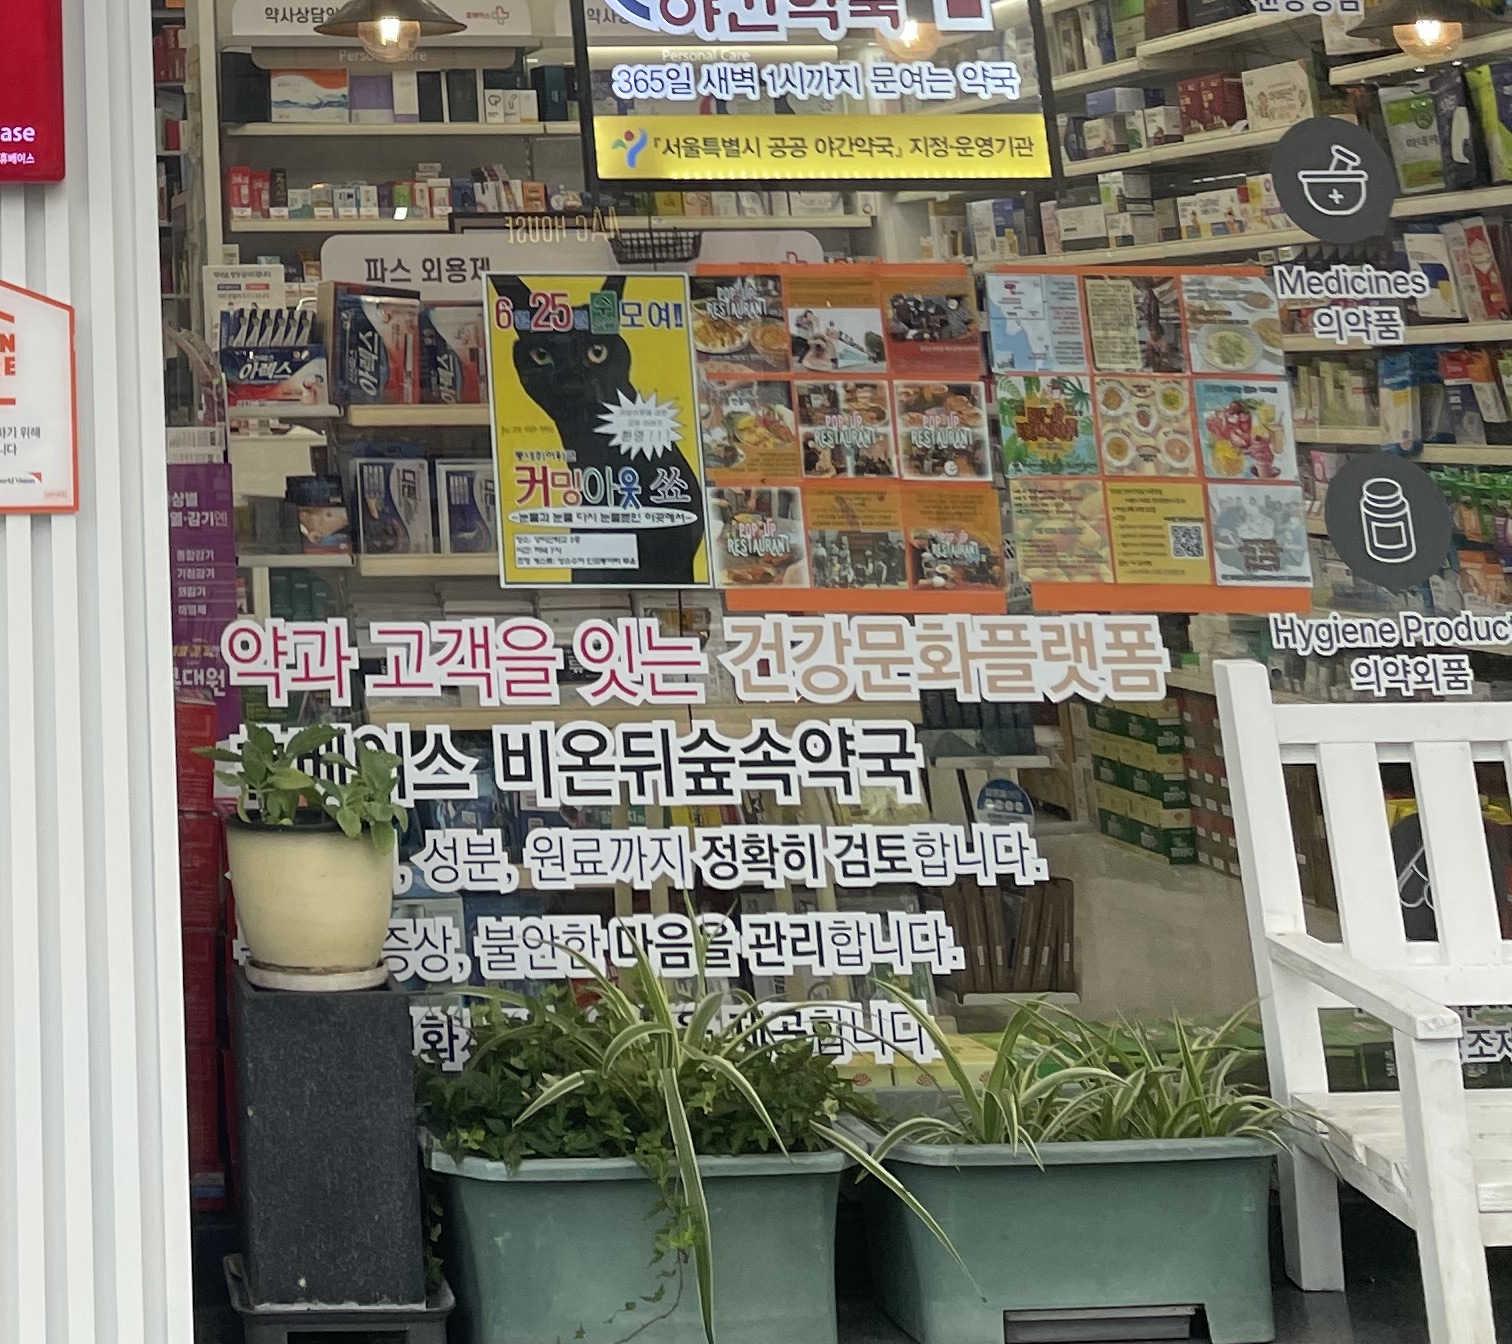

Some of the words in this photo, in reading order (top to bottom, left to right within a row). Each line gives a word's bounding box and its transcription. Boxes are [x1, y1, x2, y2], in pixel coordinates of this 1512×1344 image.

[616, 66, 693, 98] 365일
[701, 65, 758, 98] 새벽
[765, 65, 862, 98] 1시까지
[962, 64, 1020, 97] 약국
[767, 137, 808, 157] 공공
[366, 257, 413, 283] 파스
[421, 256, 490, 284] 외용제
[1277, 266, 1428, 298] Medicines
[706, 299, 768, 318] RESTAURANT
[1316, 309, 1402, 343] 의약품
[239, 361, 292, 381] 아렉스
[20, 426, 41, 440] 위해
[814, 427, 876, 448] RESTAURANT
[911, 427, 973, 448] RESTAURANT
[168, 492, 198, 508] 상별
[516, 465, 642, 510] 커밍아웃
[727, 534, 790, 556] RESTAURANT
[1273, 615, 1399, 653] Hygiene
[226, 623, 353, 701] 약과
[372, 623, 559, 701] 고객을
[578, 623, 703, 699] 잇는
[728, 618, 1165, 698] 건강문화플랫폼
[1353, 656, 1472, 695] 의약외품
[496, 724, 917, 800] 비온뒤숲속약국
[424, 833, 514, 885] 성분,
[529, 832, 688, 883] 원료까지
[701, 832, 820, 881] 정확히
[833, 830, 1044, 881] 검토합니다.
[480, 918, 603, 971] 불안한
[615, 917, 735, 972] 마음을
[748, 917, 961, 969] 관리합니다.
